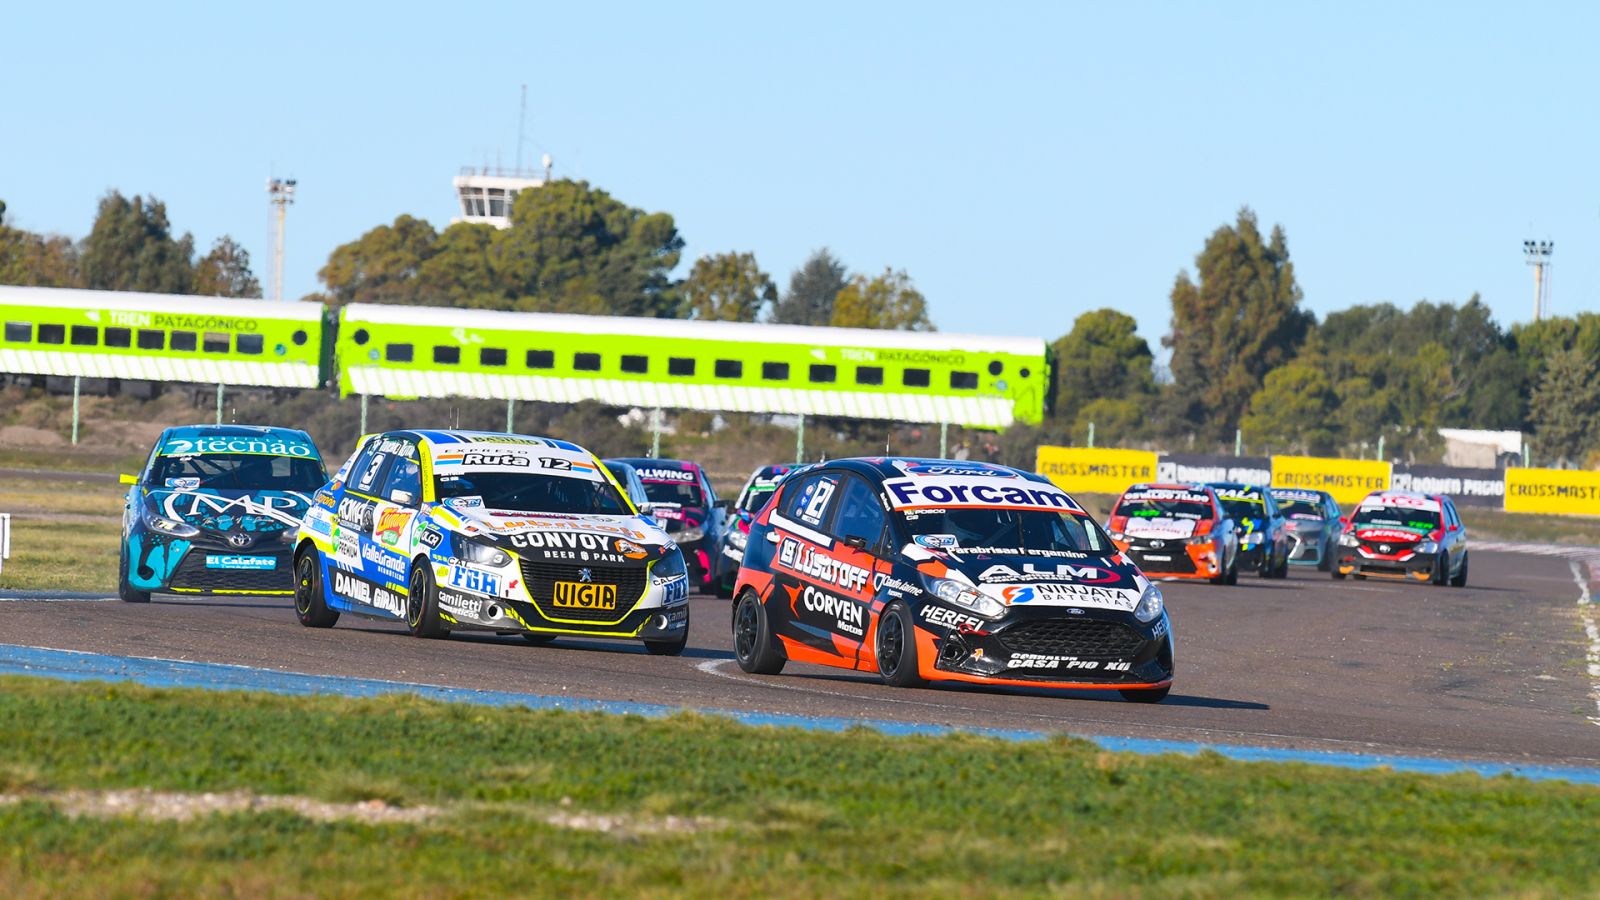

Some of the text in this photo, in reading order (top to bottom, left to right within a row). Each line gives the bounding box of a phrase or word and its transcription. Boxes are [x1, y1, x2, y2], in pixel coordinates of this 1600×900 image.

[109, 310, 150, 327] TREN
[841, 349, 876, 362] TREN
[462, 453, 573, 471] Ruta 12
[1041, 462, 1151, 479] CROSSMASTER
[1276, 472, 1384, 489] CROSSMASTER
[887, 480, 1077, 510] Forcam
[1509, 483, 1600, 501] CROSSMAST
[509, 532, 610, 551] CONVOY
[206, 555, 276, 566] El Calafate
[362, 543, 406, 575] ValleGrande
[544, 550, 625, 563] BEER PARK
[452, 566, 498, 596] FGH
[978, 563, 1098, 582] ALM
[335, 572, 372, 605] DANIEL
[1035, 584, 1132, 602] NINJATA
[438, 590, 482, 612] camiletti
[803, 585, 863, 627] CORVEN
[1042, 594, 1134, 610] BATERIAS
[836, 619, 864, 637] Motos
[1006, 659, 1060, 669] CASA
[1066, 661, 1100, 669] PIO
